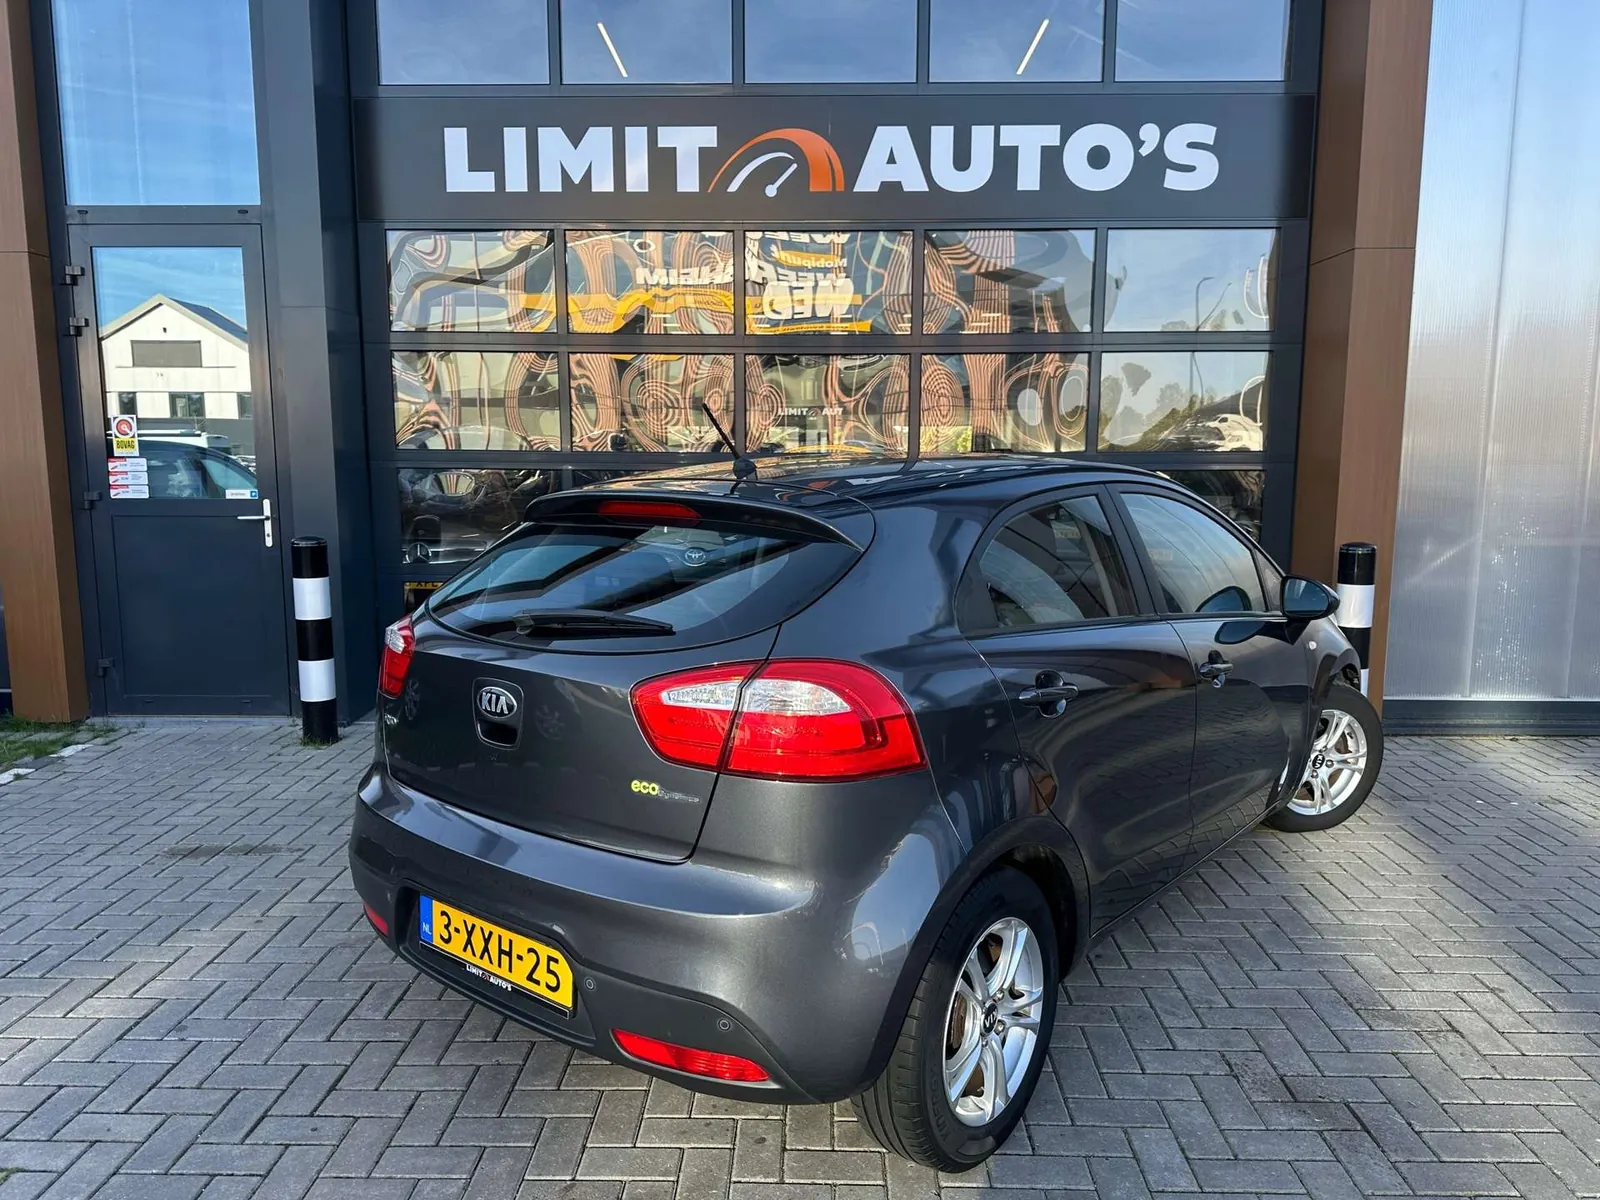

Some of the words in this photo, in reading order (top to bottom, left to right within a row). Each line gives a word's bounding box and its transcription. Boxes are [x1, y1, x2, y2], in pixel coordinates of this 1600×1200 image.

[443, 125, 718, 193] LIMIT
[852, 122, 1220, 193] AUTO'S
[777, 407, 809, 416] LIMIT
[116, 440, 135, 450] BOVAG
[480, 692, 509, 714] KIA
[422, 921, 432, 936] NL
[439, 910, 561, 993] 3-XXH-25
[466, 964, 482, 978] LIMIT
[489, 976, 512, 992] AUTO'S
